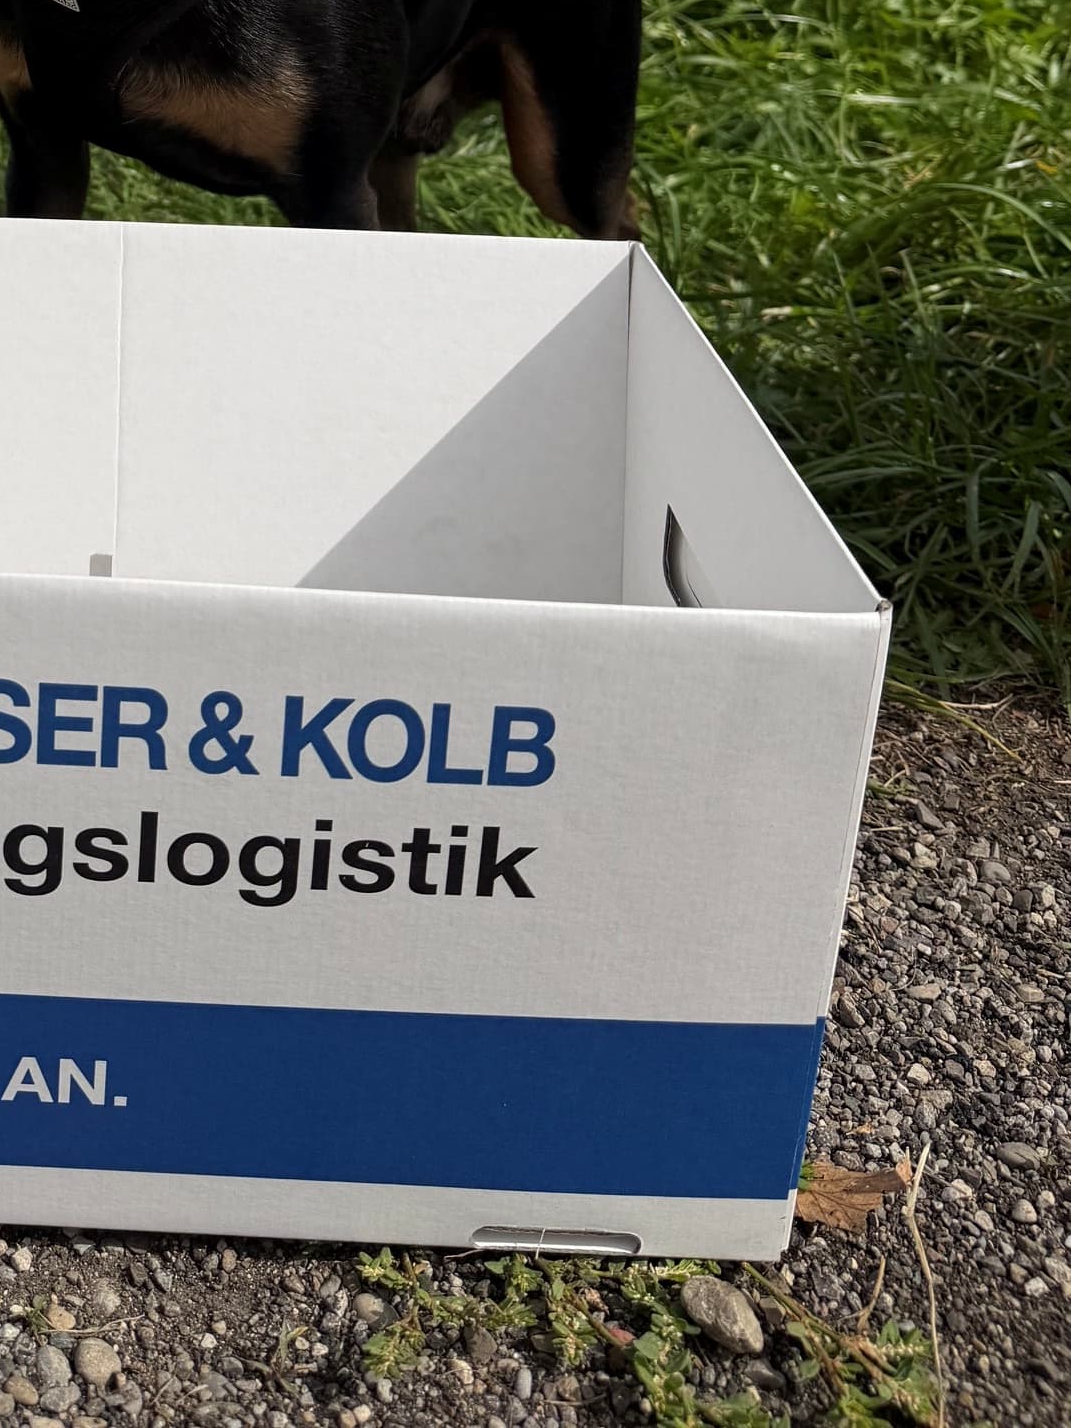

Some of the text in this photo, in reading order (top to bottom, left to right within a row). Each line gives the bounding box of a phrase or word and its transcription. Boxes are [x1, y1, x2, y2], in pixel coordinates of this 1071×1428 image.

[188, 690, 261, 776] &
[280, 695, 557, 788] KOLB
[0, 1056, 129, 1108] AN.
